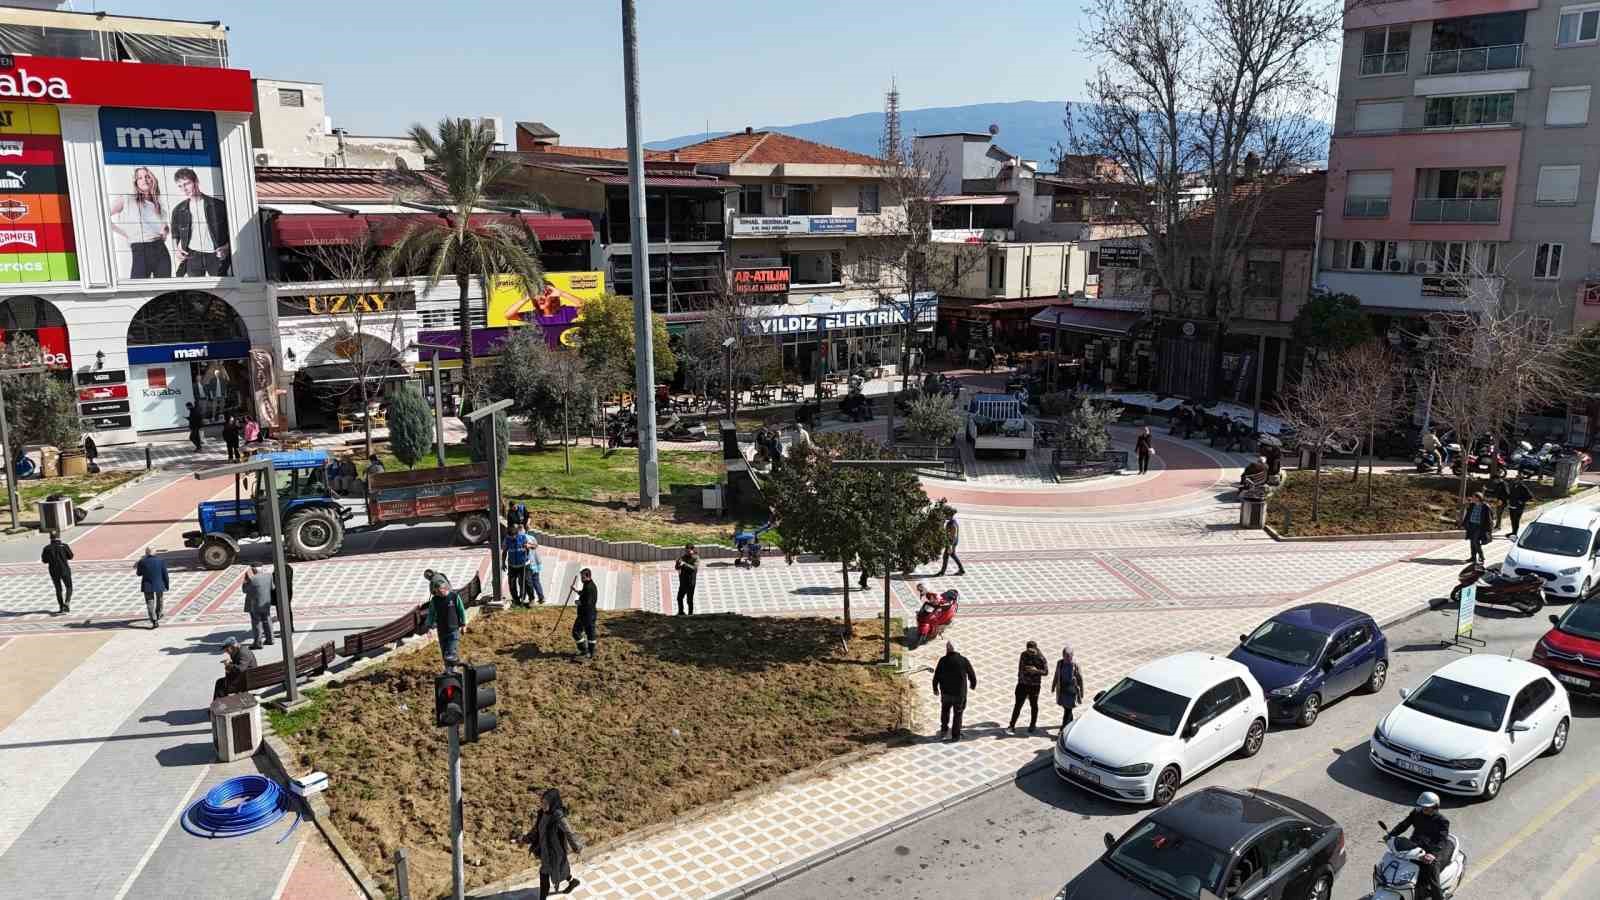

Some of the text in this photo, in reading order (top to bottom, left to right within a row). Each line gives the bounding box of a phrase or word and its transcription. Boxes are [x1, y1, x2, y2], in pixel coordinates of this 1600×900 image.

[115, 123, 204, 150] mavi
[760, 317, 817, 333] YILDIZ
[826, 308, 905, 329] ELEKTRİK
[174, 346, 208, 359] mavi
